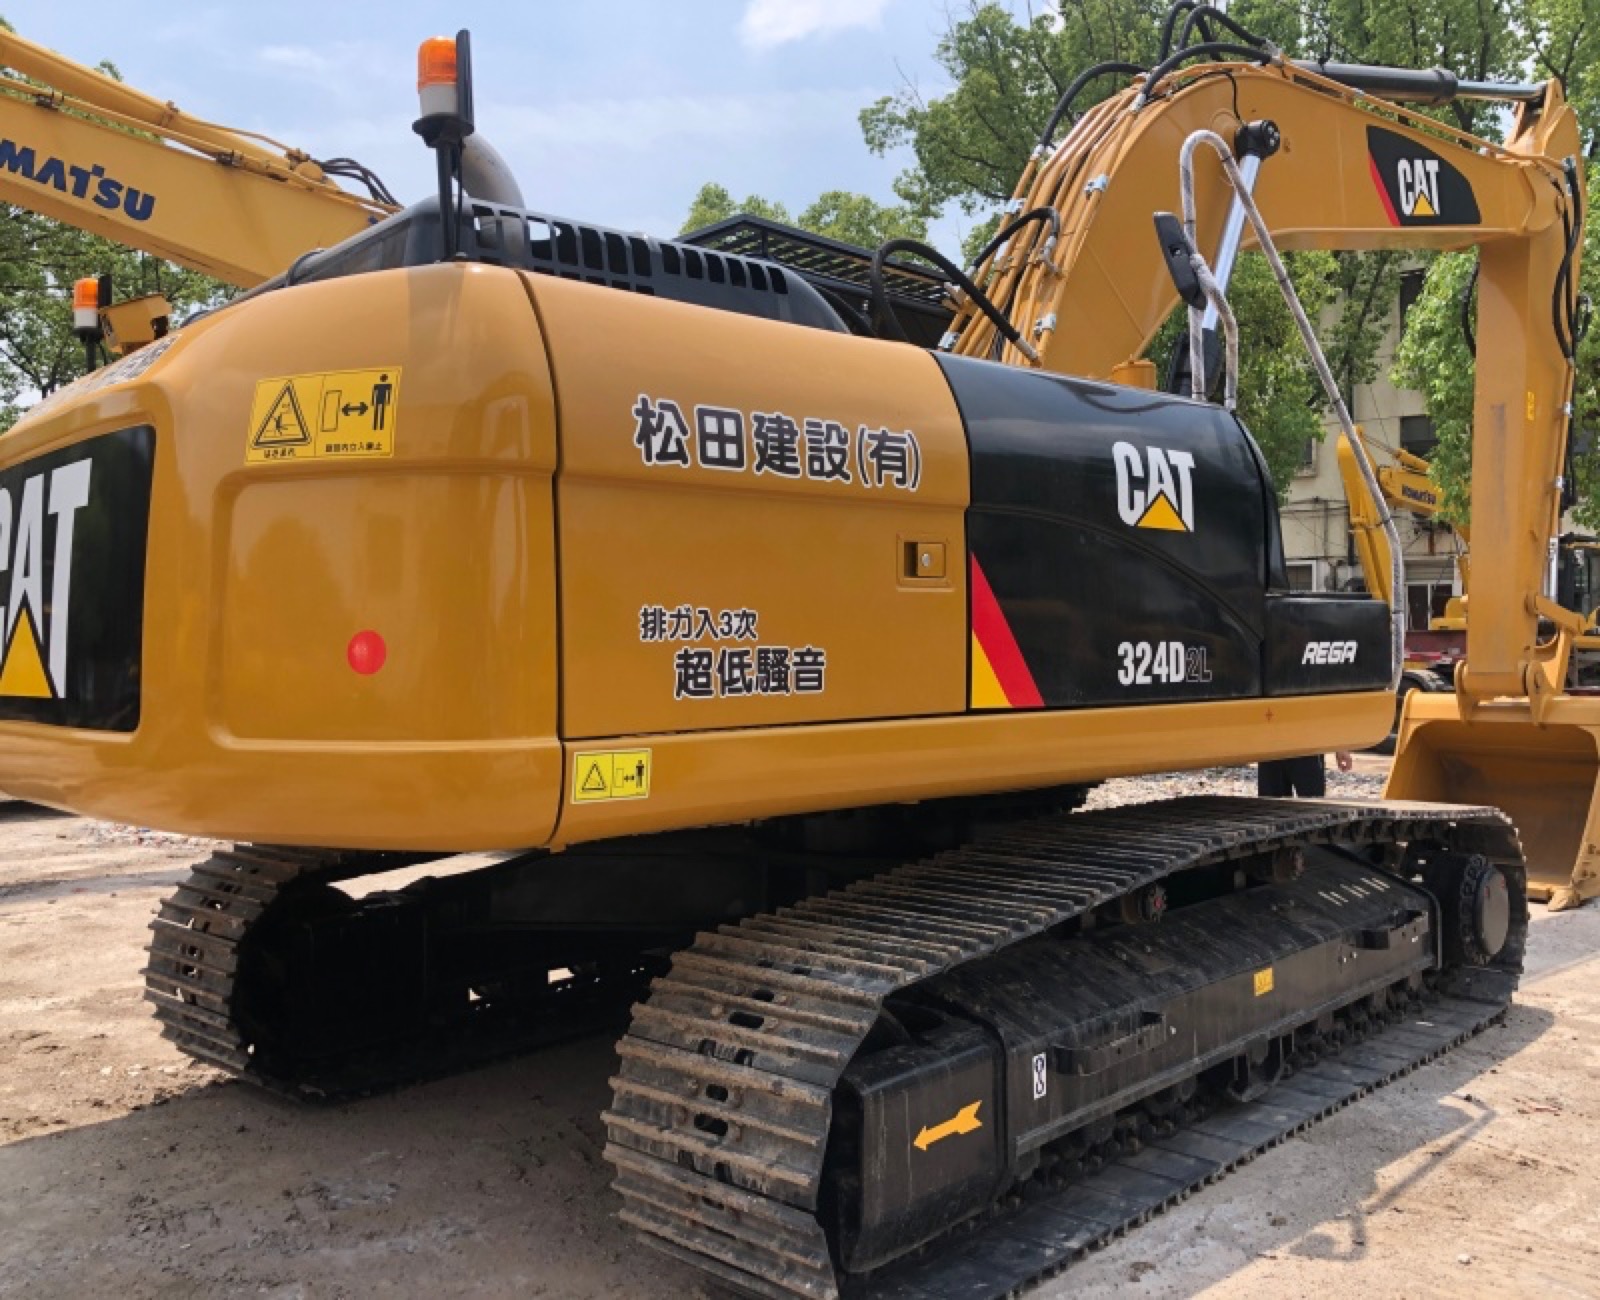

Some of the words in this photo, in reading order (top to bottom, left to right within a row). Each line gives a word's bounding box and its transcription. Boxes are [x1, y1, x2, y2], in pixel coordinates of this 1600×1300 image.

[1397, 158, 1440, 216] CAT
[632, 394, 921, 491] 松田建設(有)
[1112, 441, 1196, 532] CAT
[639, 604, 758, 641] 排ガ入3次
[673, 645, 826, 699] 超低騒音
[1301, 640, 1358, 665] REGA
